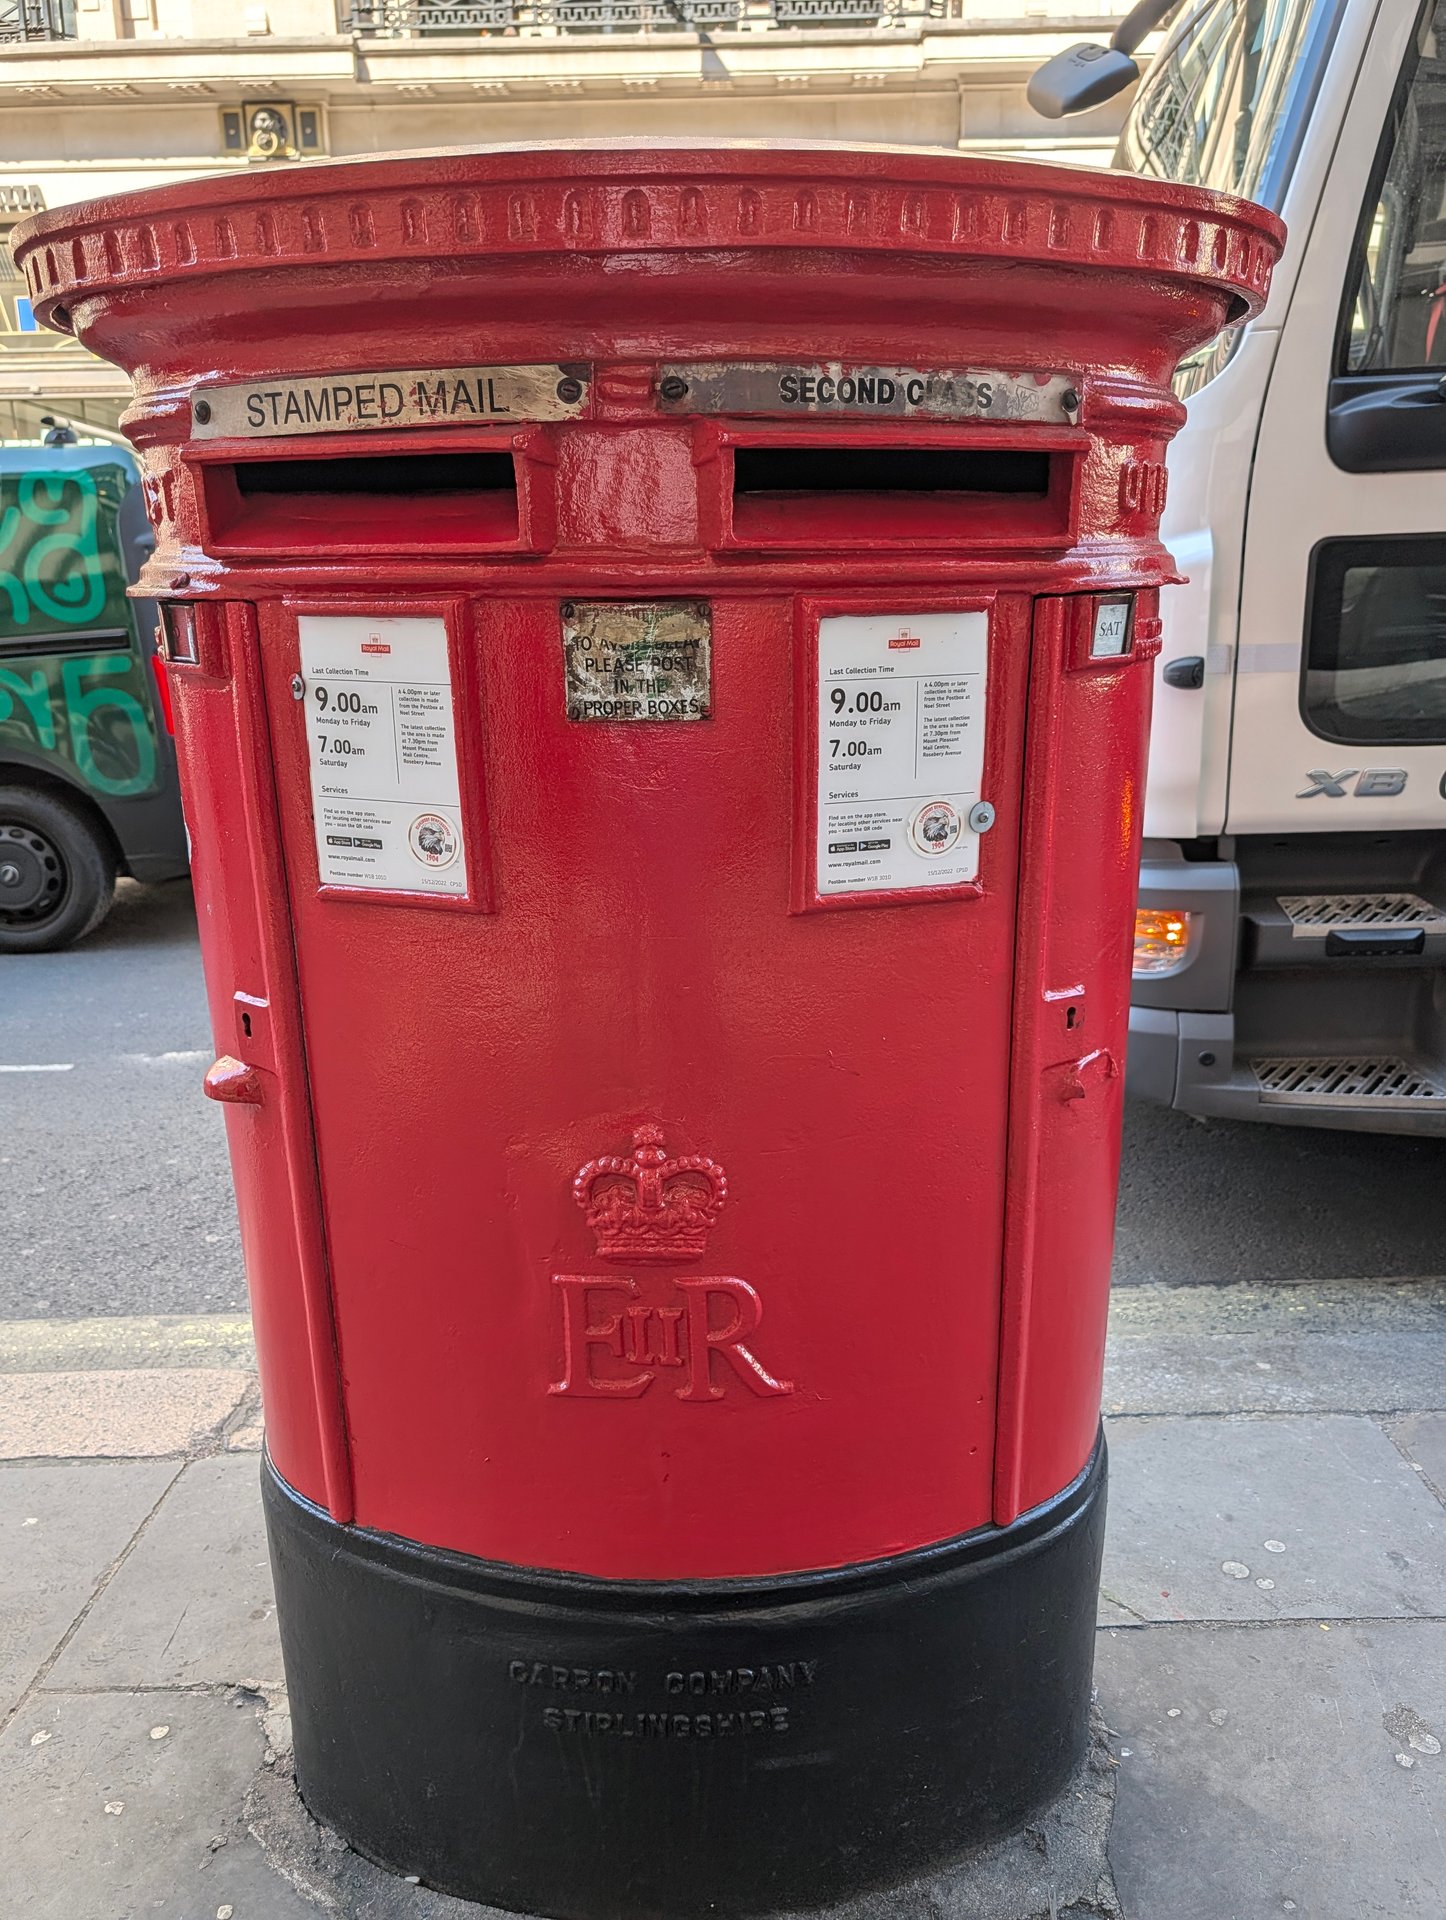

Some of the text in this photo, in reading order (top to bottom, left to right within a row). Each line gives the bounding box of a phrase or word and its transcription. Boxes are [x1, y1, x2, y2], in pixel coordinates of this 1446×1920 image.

[779, 376, 992, 409] SECOND CLS
[247, 378, 510, 428] STAMPED MAIL
[1099, 621, 1122, 637] SAT
[362, 644, 377, 653] Royal
[574, 636, 592, 651] TO
[890, 639, 919, 649] Royal Mail
[585, 656, 692, 673] PLEASE POST
[312, 667, 324, 675] Last
[325, 668, 353, 676] Collection
[829, 667, 844, 675] Last
[845, 666, 877, 674] Collection
[614, 679, 666, 693] IN THE
[315, 686, 378, 714] 9.00am
[830, 688, 901, 714] 9.00am
[584, 699, 699, 715] PROPER BOXES
[316, 717, 340, 726] Monday
[350, 719, 371, 728] Friday
[829, 719, 857, 728] Monday
[869, 717, 891, 726] Friday
[318, 735, 365, 756] 7.00am
[829, 739, 882, 757] 7.00am
[319, 759, 348, 768] Saturday
[829, 762, 861, 772] Saturday
[1295, 767, 1409, 798] XB
[321, 785, 349, 795] Services
[829, 790, 859, 799] Services
[931, 841, 945, 850] 1904
[328, 854, 376, 863] www.royalmail.com
[426, 854, 439, 863] 1904
[828, 859, 881, 868] www.royalmail.com
[666, 1659, 817, 1694] COMPANY
